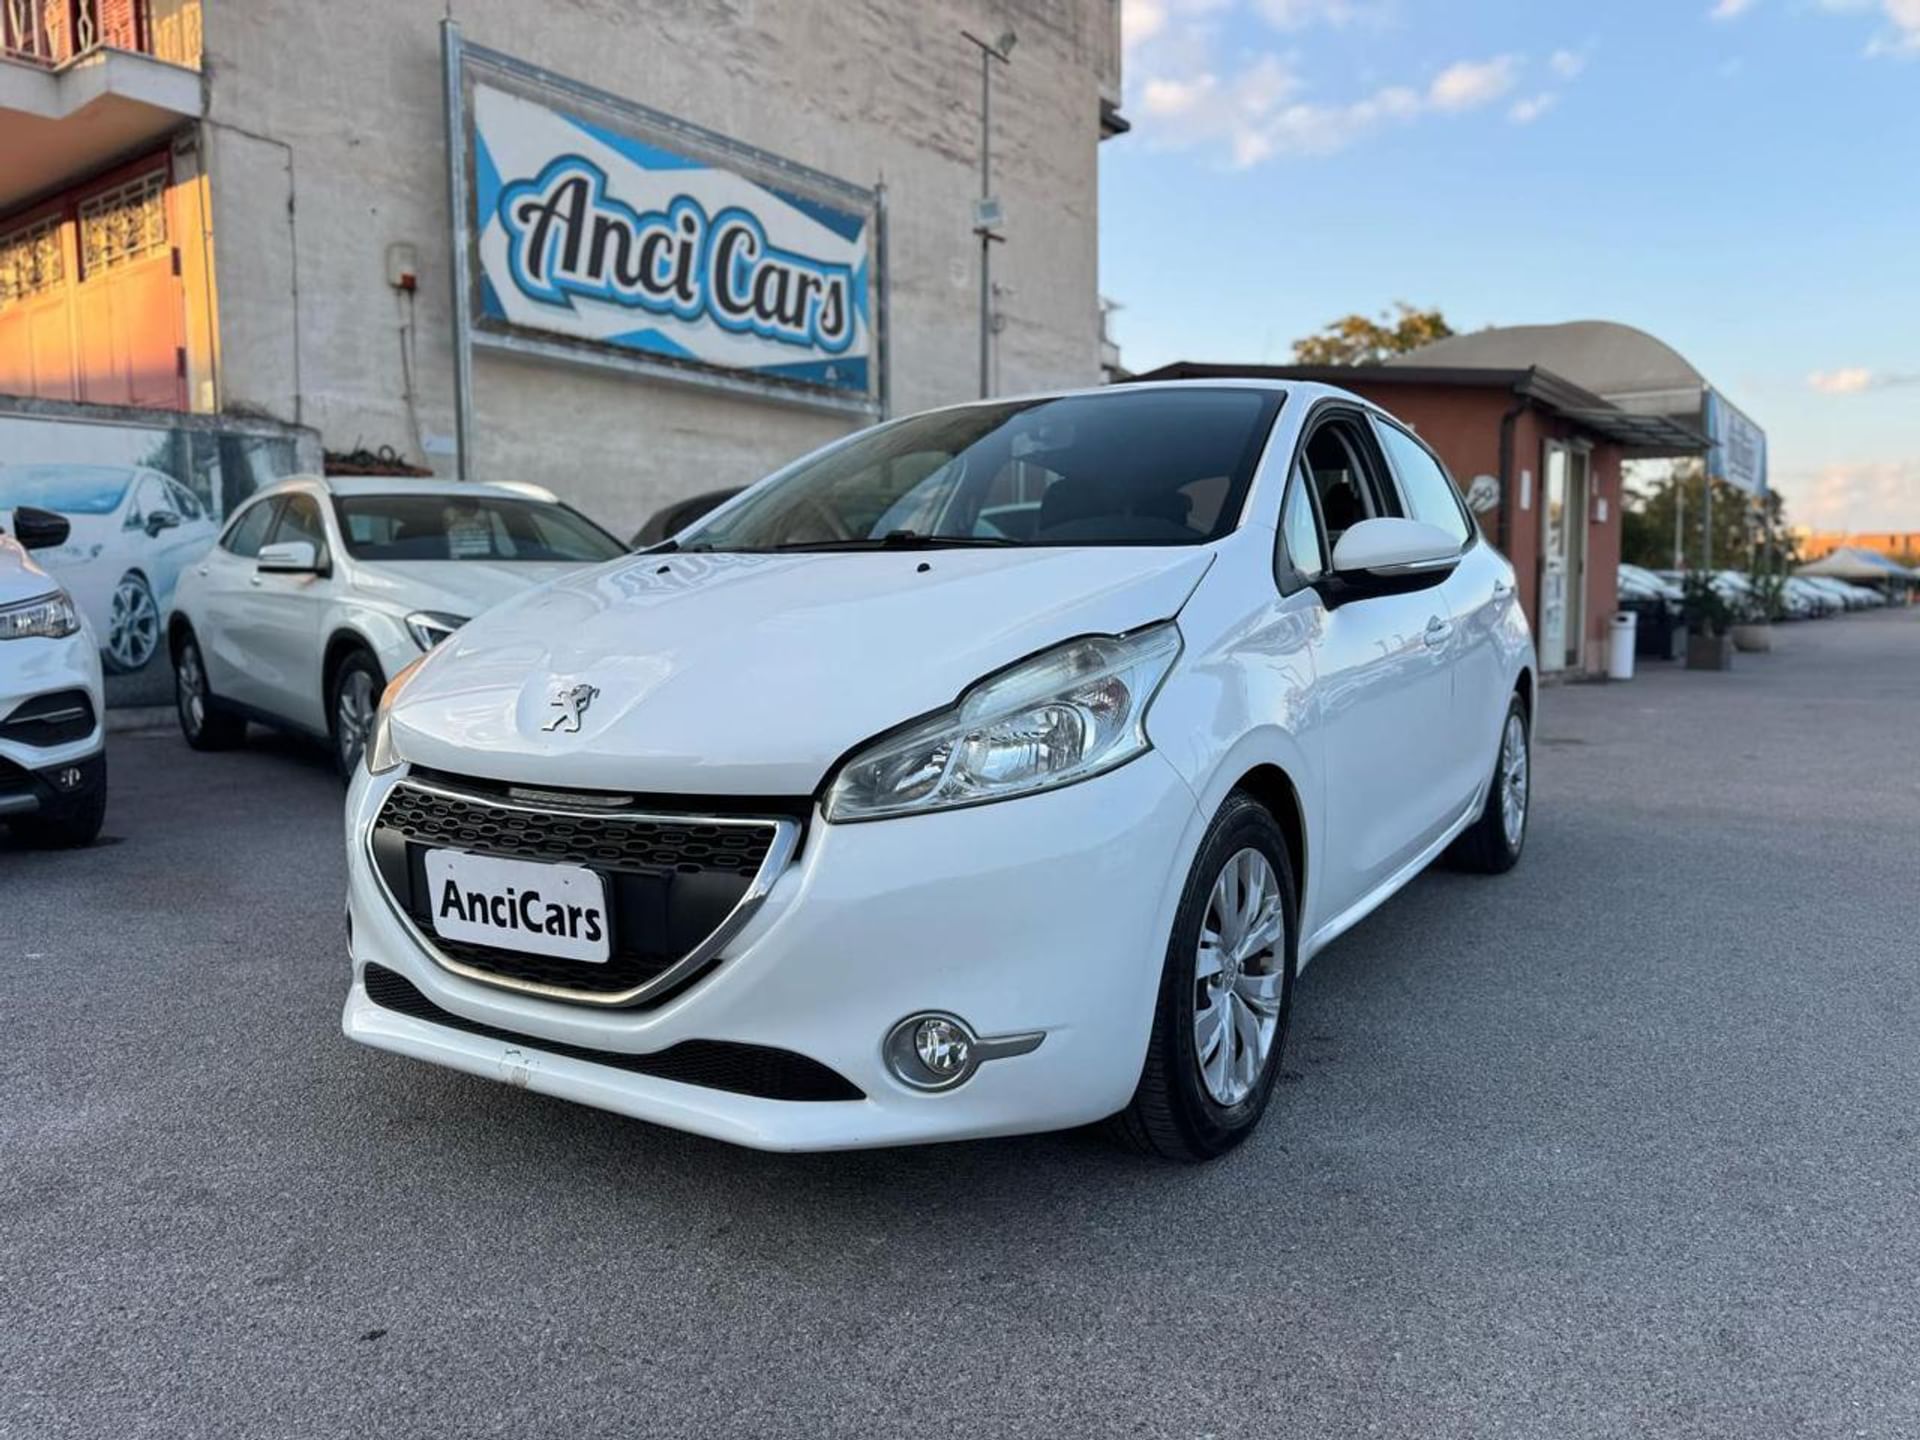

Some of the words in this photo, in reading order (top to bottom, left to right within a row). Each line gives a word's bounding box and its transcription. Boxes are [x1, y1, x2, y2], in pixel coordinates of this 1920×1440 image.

[517, 176, 696, 302] Anci
[714, 225, 844, 336] Cars
[440, 879, 602, 942] AnciCars
